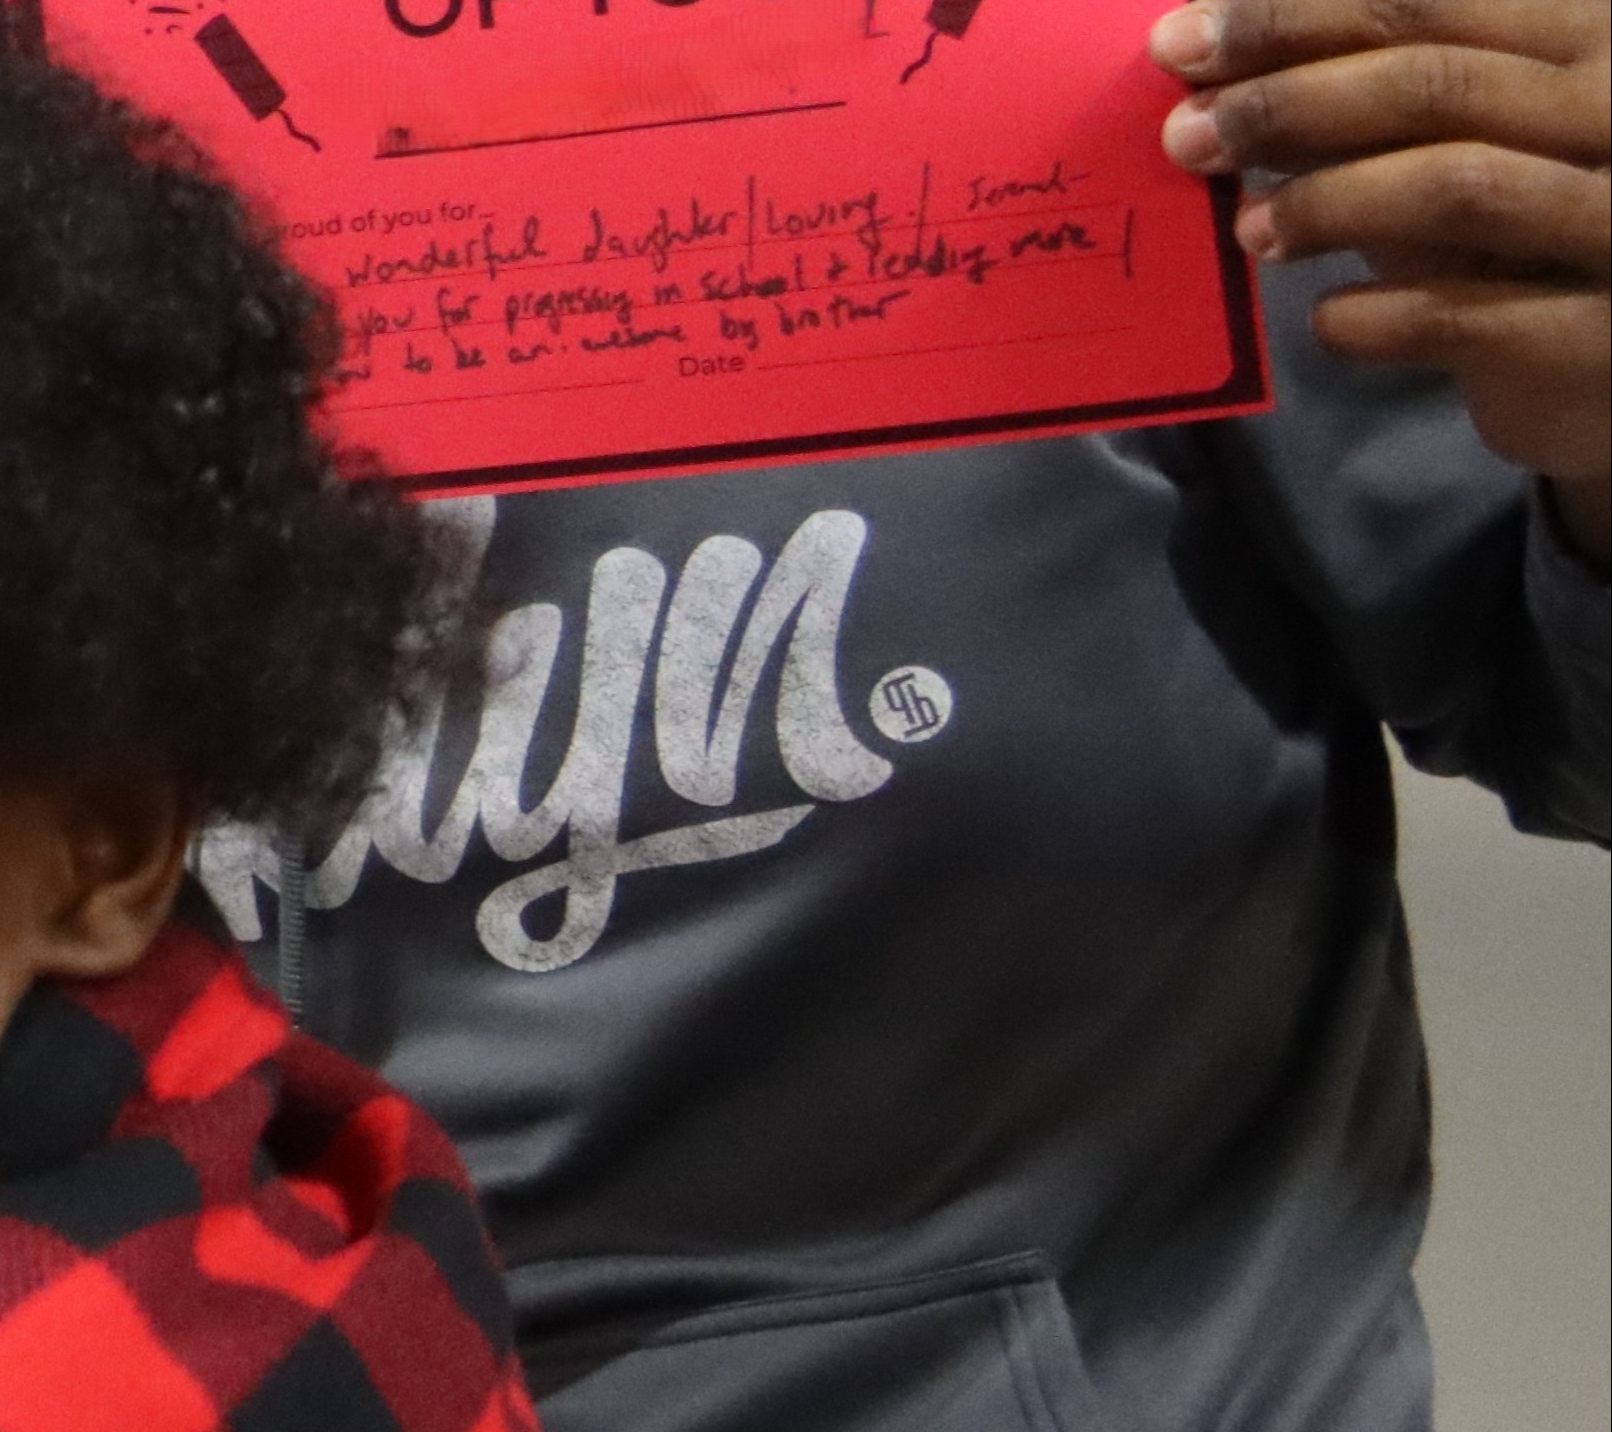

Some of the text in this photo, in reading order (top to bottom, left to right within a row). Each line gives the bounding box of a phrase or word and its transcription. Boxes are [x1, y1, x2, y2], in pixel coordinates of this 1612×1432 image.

[351, 209, 376, 234] of
[382, 208, 432, 236] you
[678, 355, 745, 379] Date
